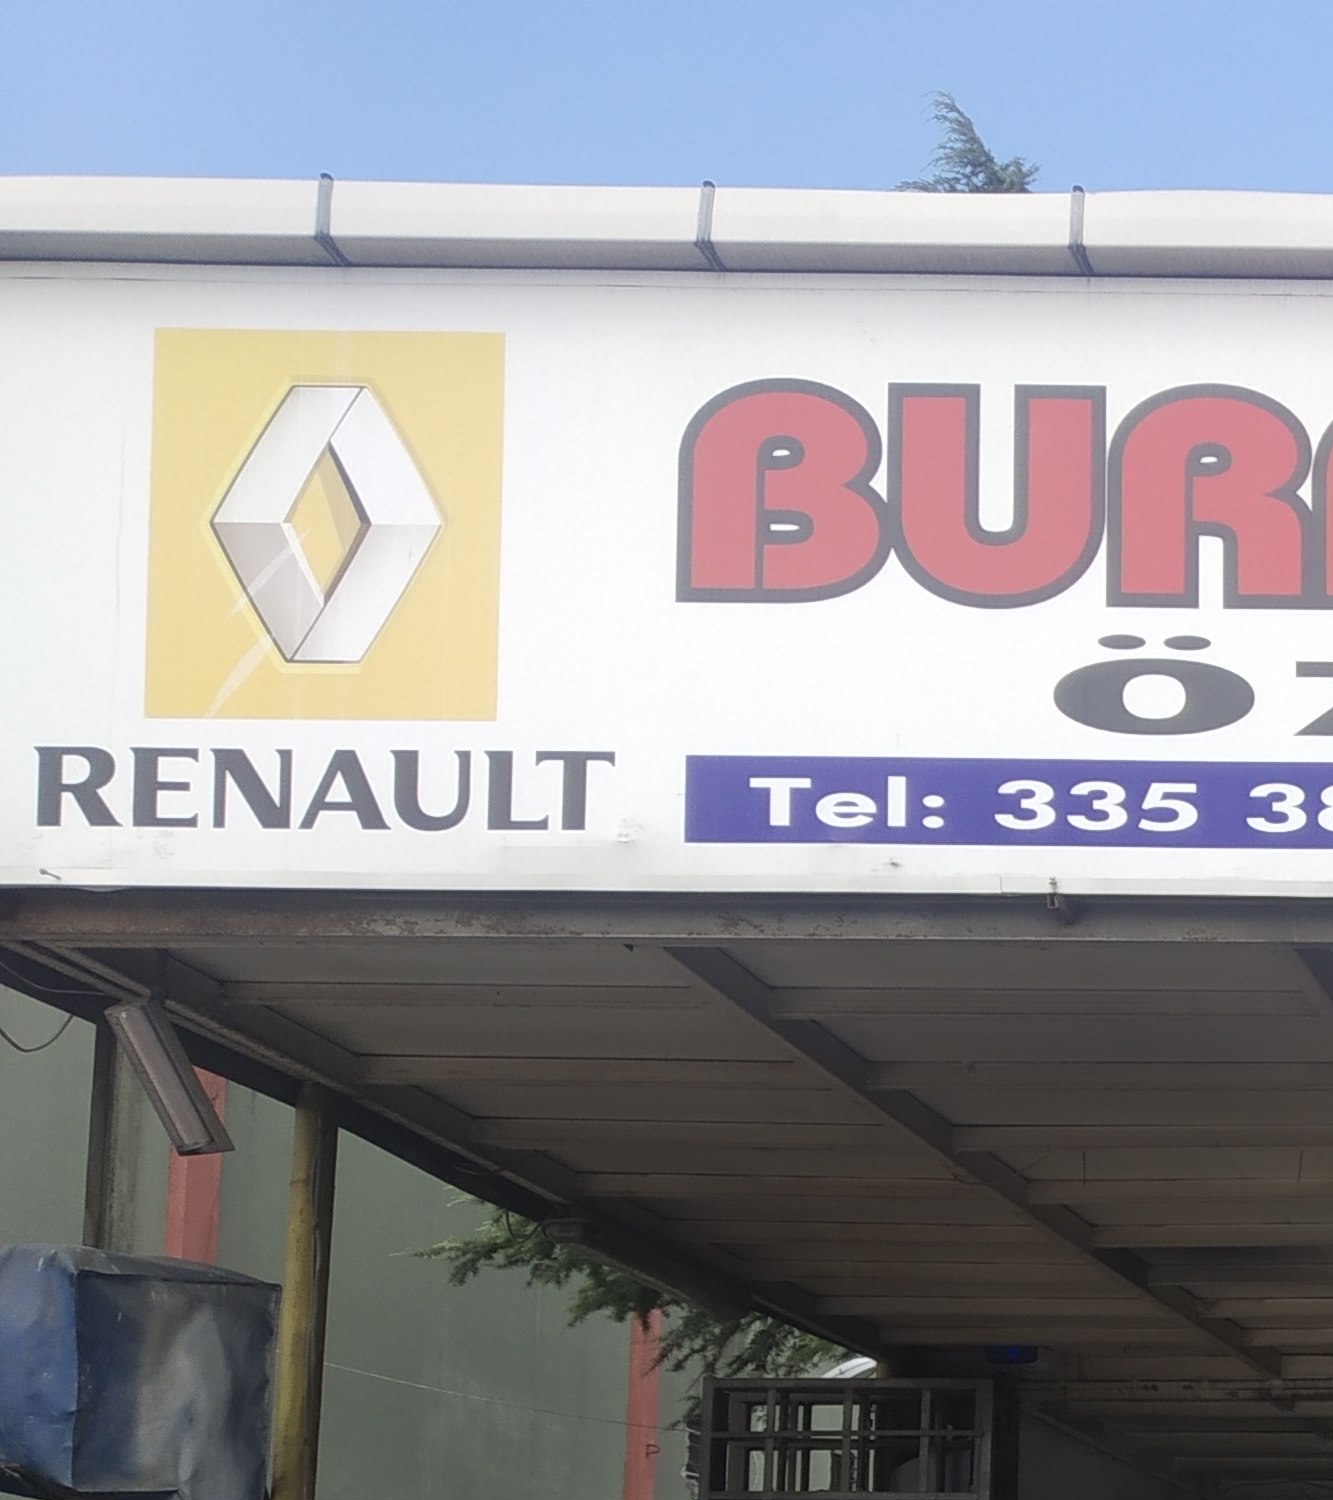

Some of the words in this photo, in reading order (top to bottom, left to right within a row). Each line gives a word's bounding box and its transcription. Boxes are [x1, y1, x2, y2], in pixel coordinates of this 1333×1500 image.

[33, 745, 616, 832] RENAULT
[748, 775, 945, 829] Tel:
[994, 779, 1199, 833] 335
